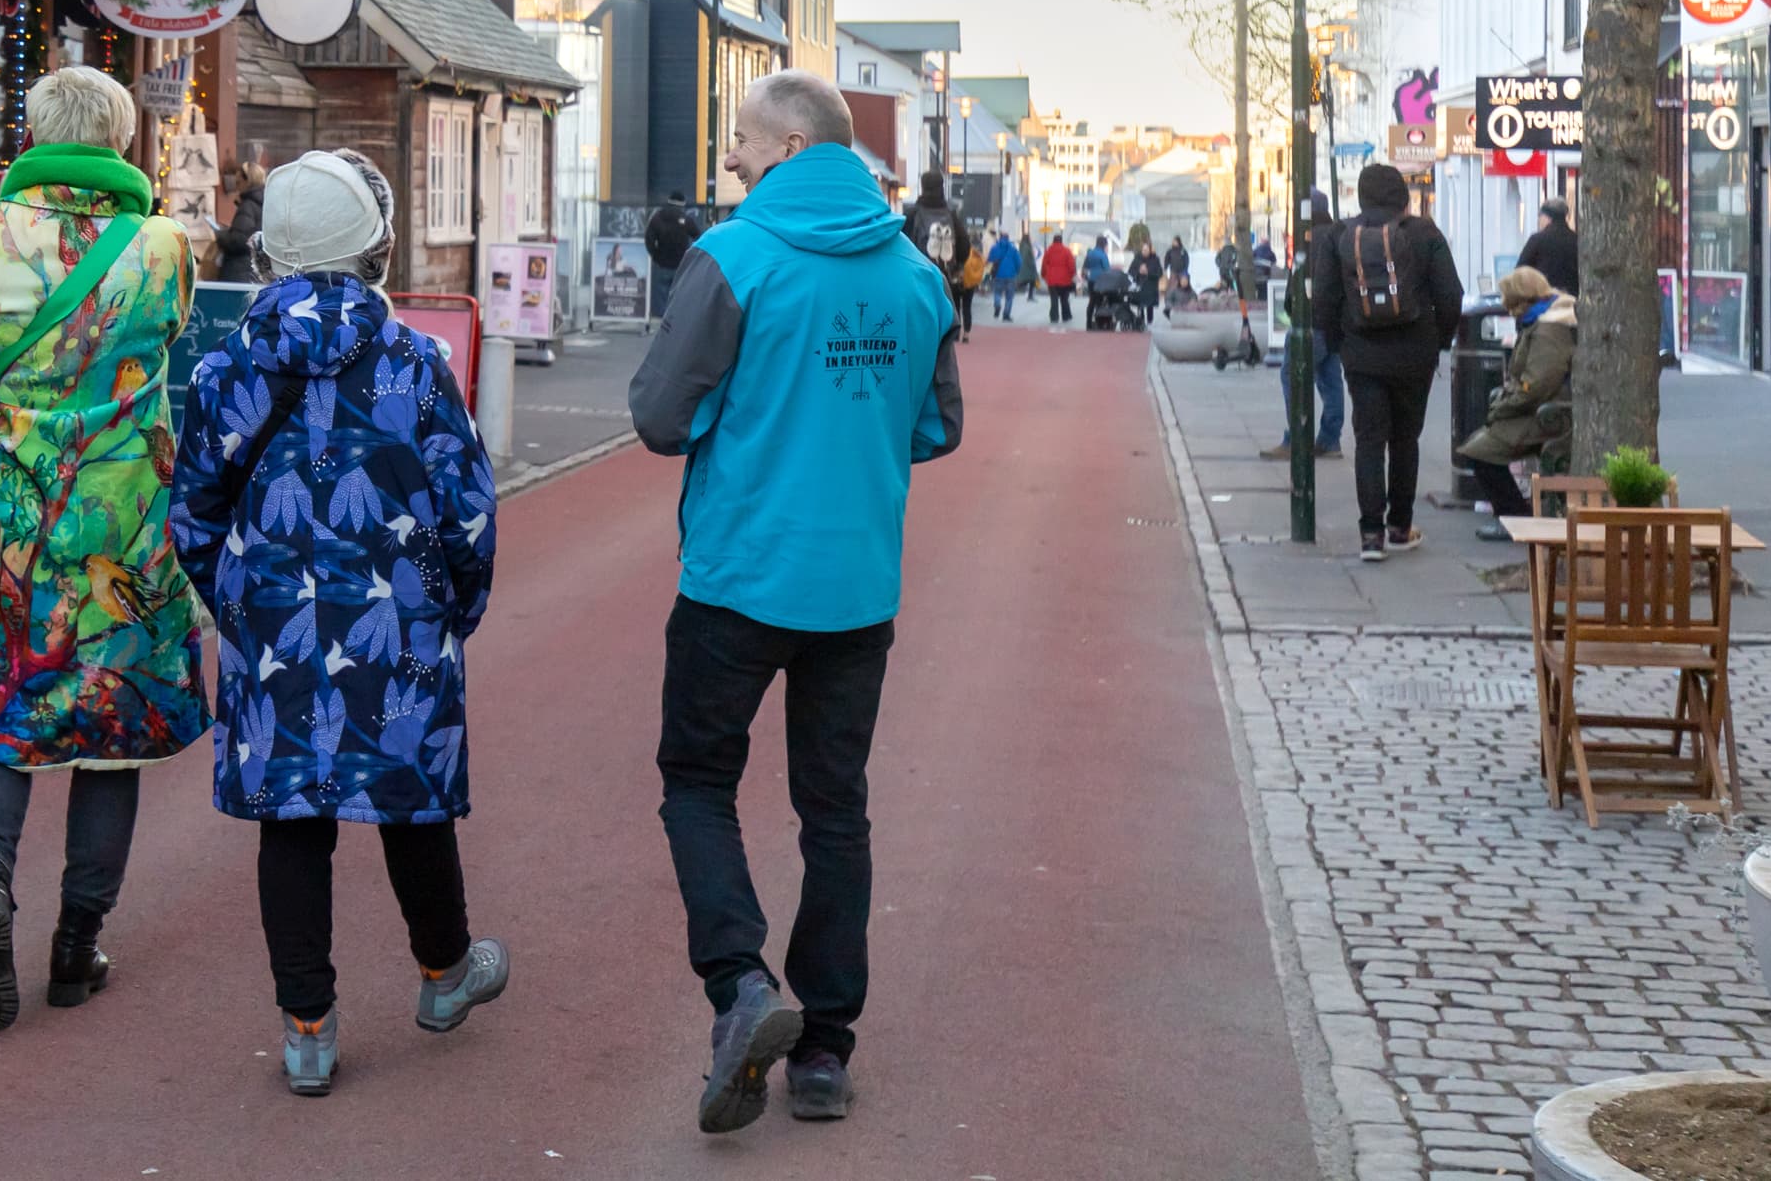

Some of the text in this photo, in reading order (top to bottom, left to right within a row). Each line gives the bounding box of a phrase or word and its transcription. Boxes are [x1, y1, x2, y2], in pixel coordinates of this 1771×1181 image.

[145, 82, 183, 95] TAX FREE
[1488, 78, 1558, 100] What's
[827, 339, 897, 352] YOUR FRIEND
[825, 356, 838, 368] IN
